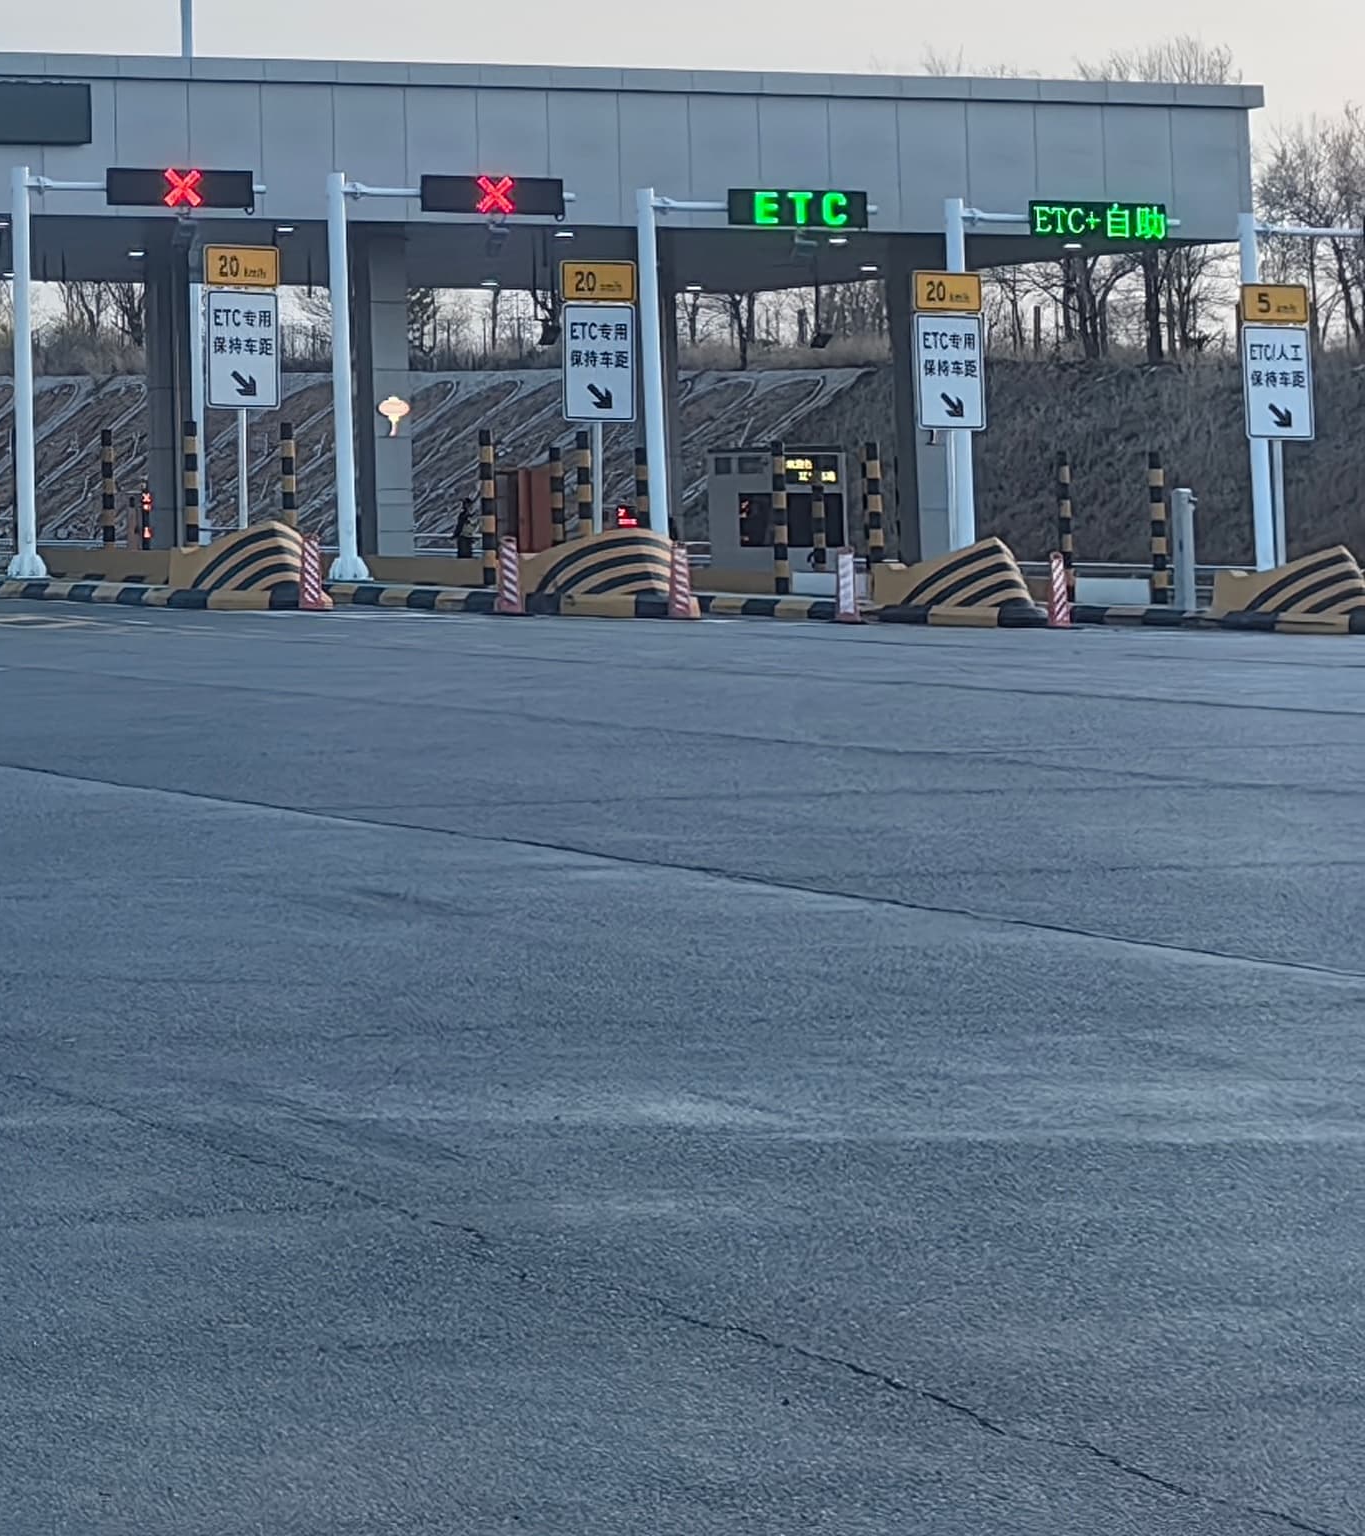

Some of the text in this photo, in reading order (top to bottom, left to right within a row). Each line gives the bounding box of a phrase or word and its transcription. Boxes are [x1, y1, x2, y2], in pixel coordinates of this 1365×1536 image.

[754, 191, 847, 225] ETC
[1033, 203, 1165, 239] ETC+自助
[219, 255, 239, 277] 20
[575, 271, 596, 292] 20
[926, 280, 945, 302] 20
[1257, 292, 1271, 313] 5
[213, 309, 272, 328] ETC专用
[570, 322, 627, 341] ETC专用
[923, 331, 975, 350] ETC专用
[213, 336, 274, 356] 保持车距
[570, 349, 629, 368] 保持车距
[924, 359, 978, 378] 保持车距
[1250, 370, 1306, 388] 保持车距
